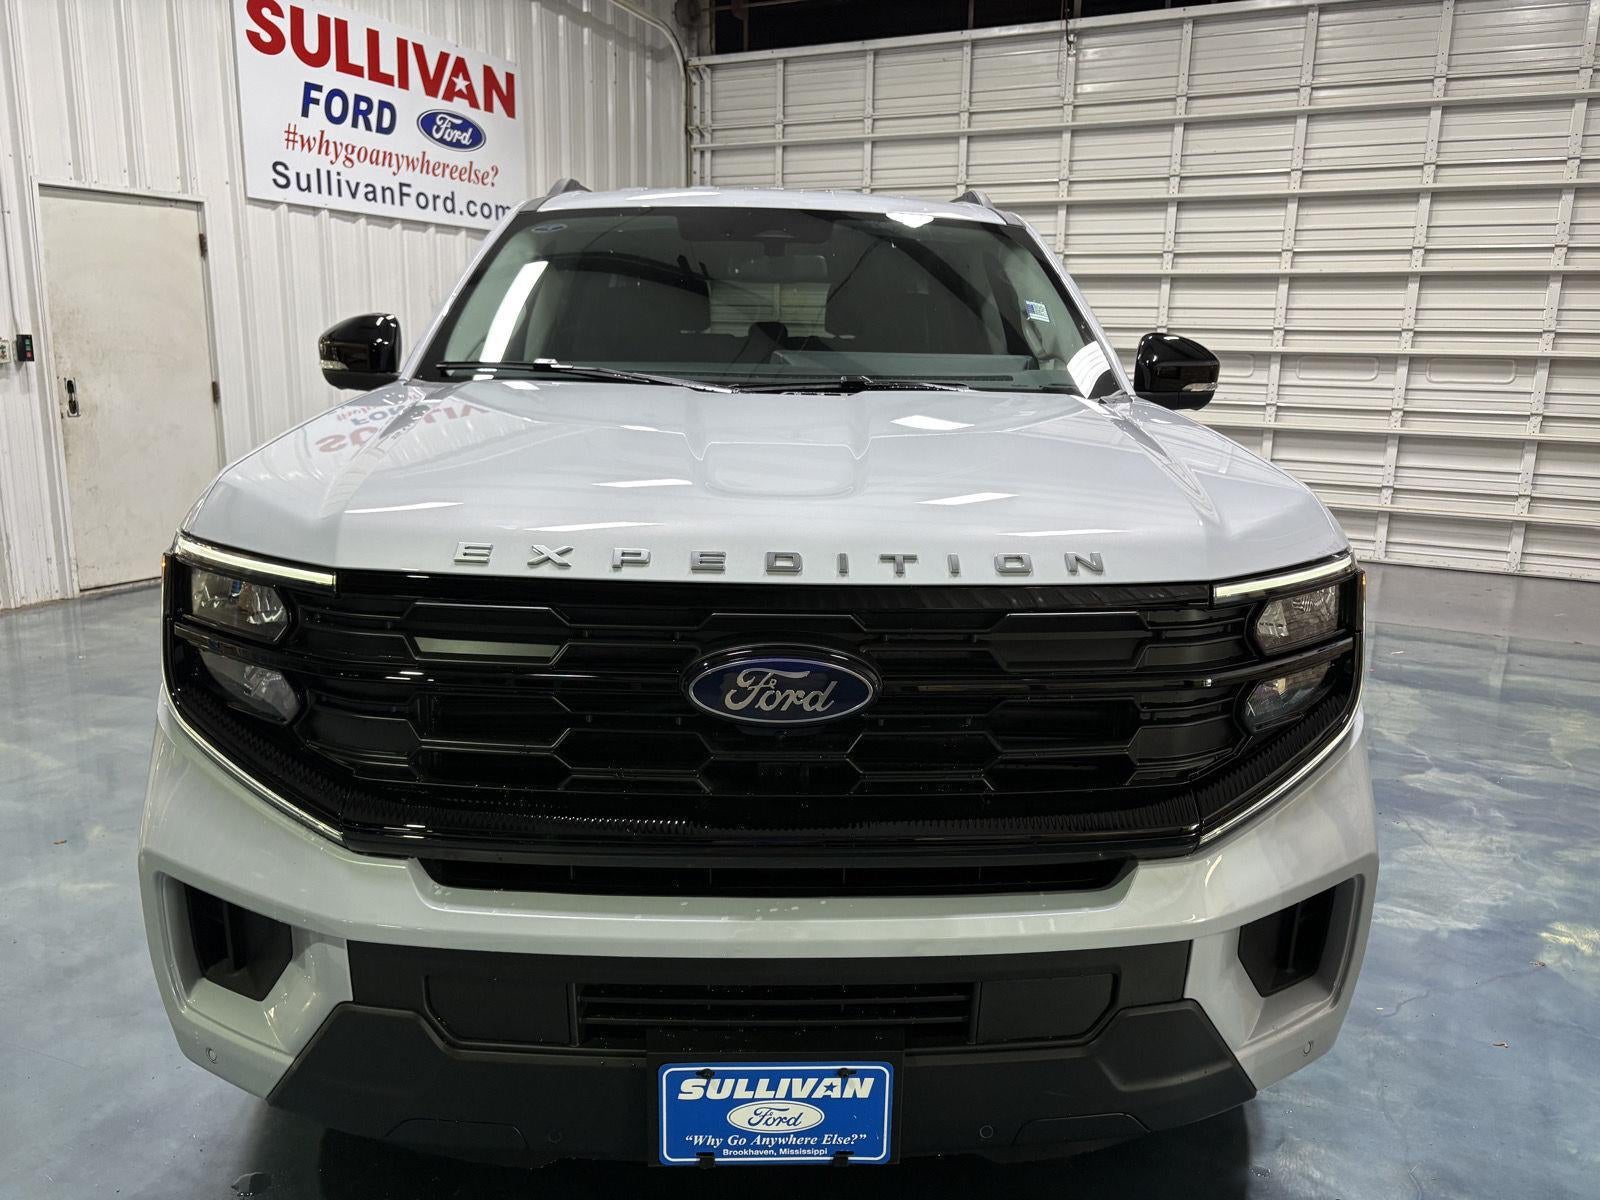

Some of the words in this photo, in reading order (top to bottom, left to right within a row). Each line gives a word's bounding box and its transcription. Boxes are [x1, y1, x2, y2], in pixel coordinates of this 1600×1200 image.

[246, 0, 516, 119] SULLIVAN
[300, 81, 397, 135] FORD
[432, 113, 472, 146] Ford
[284, 123, 499, 187] #whygoanywhereelse?
[453, 542, 1106, 576] EXPEDITION
[724, 667, 838, 712] Ford
[678, 1077, 875, 1100] SULLIVAN
[748, 1106, 802, 1127] Ford
[722, 1148, 777, 1156] Brookhaven,
[779, 1148, 828, 1156] Mississippi
[727, 1135, 747, 1146] Go
[751, 1134, 818, 1147] Anywhere
